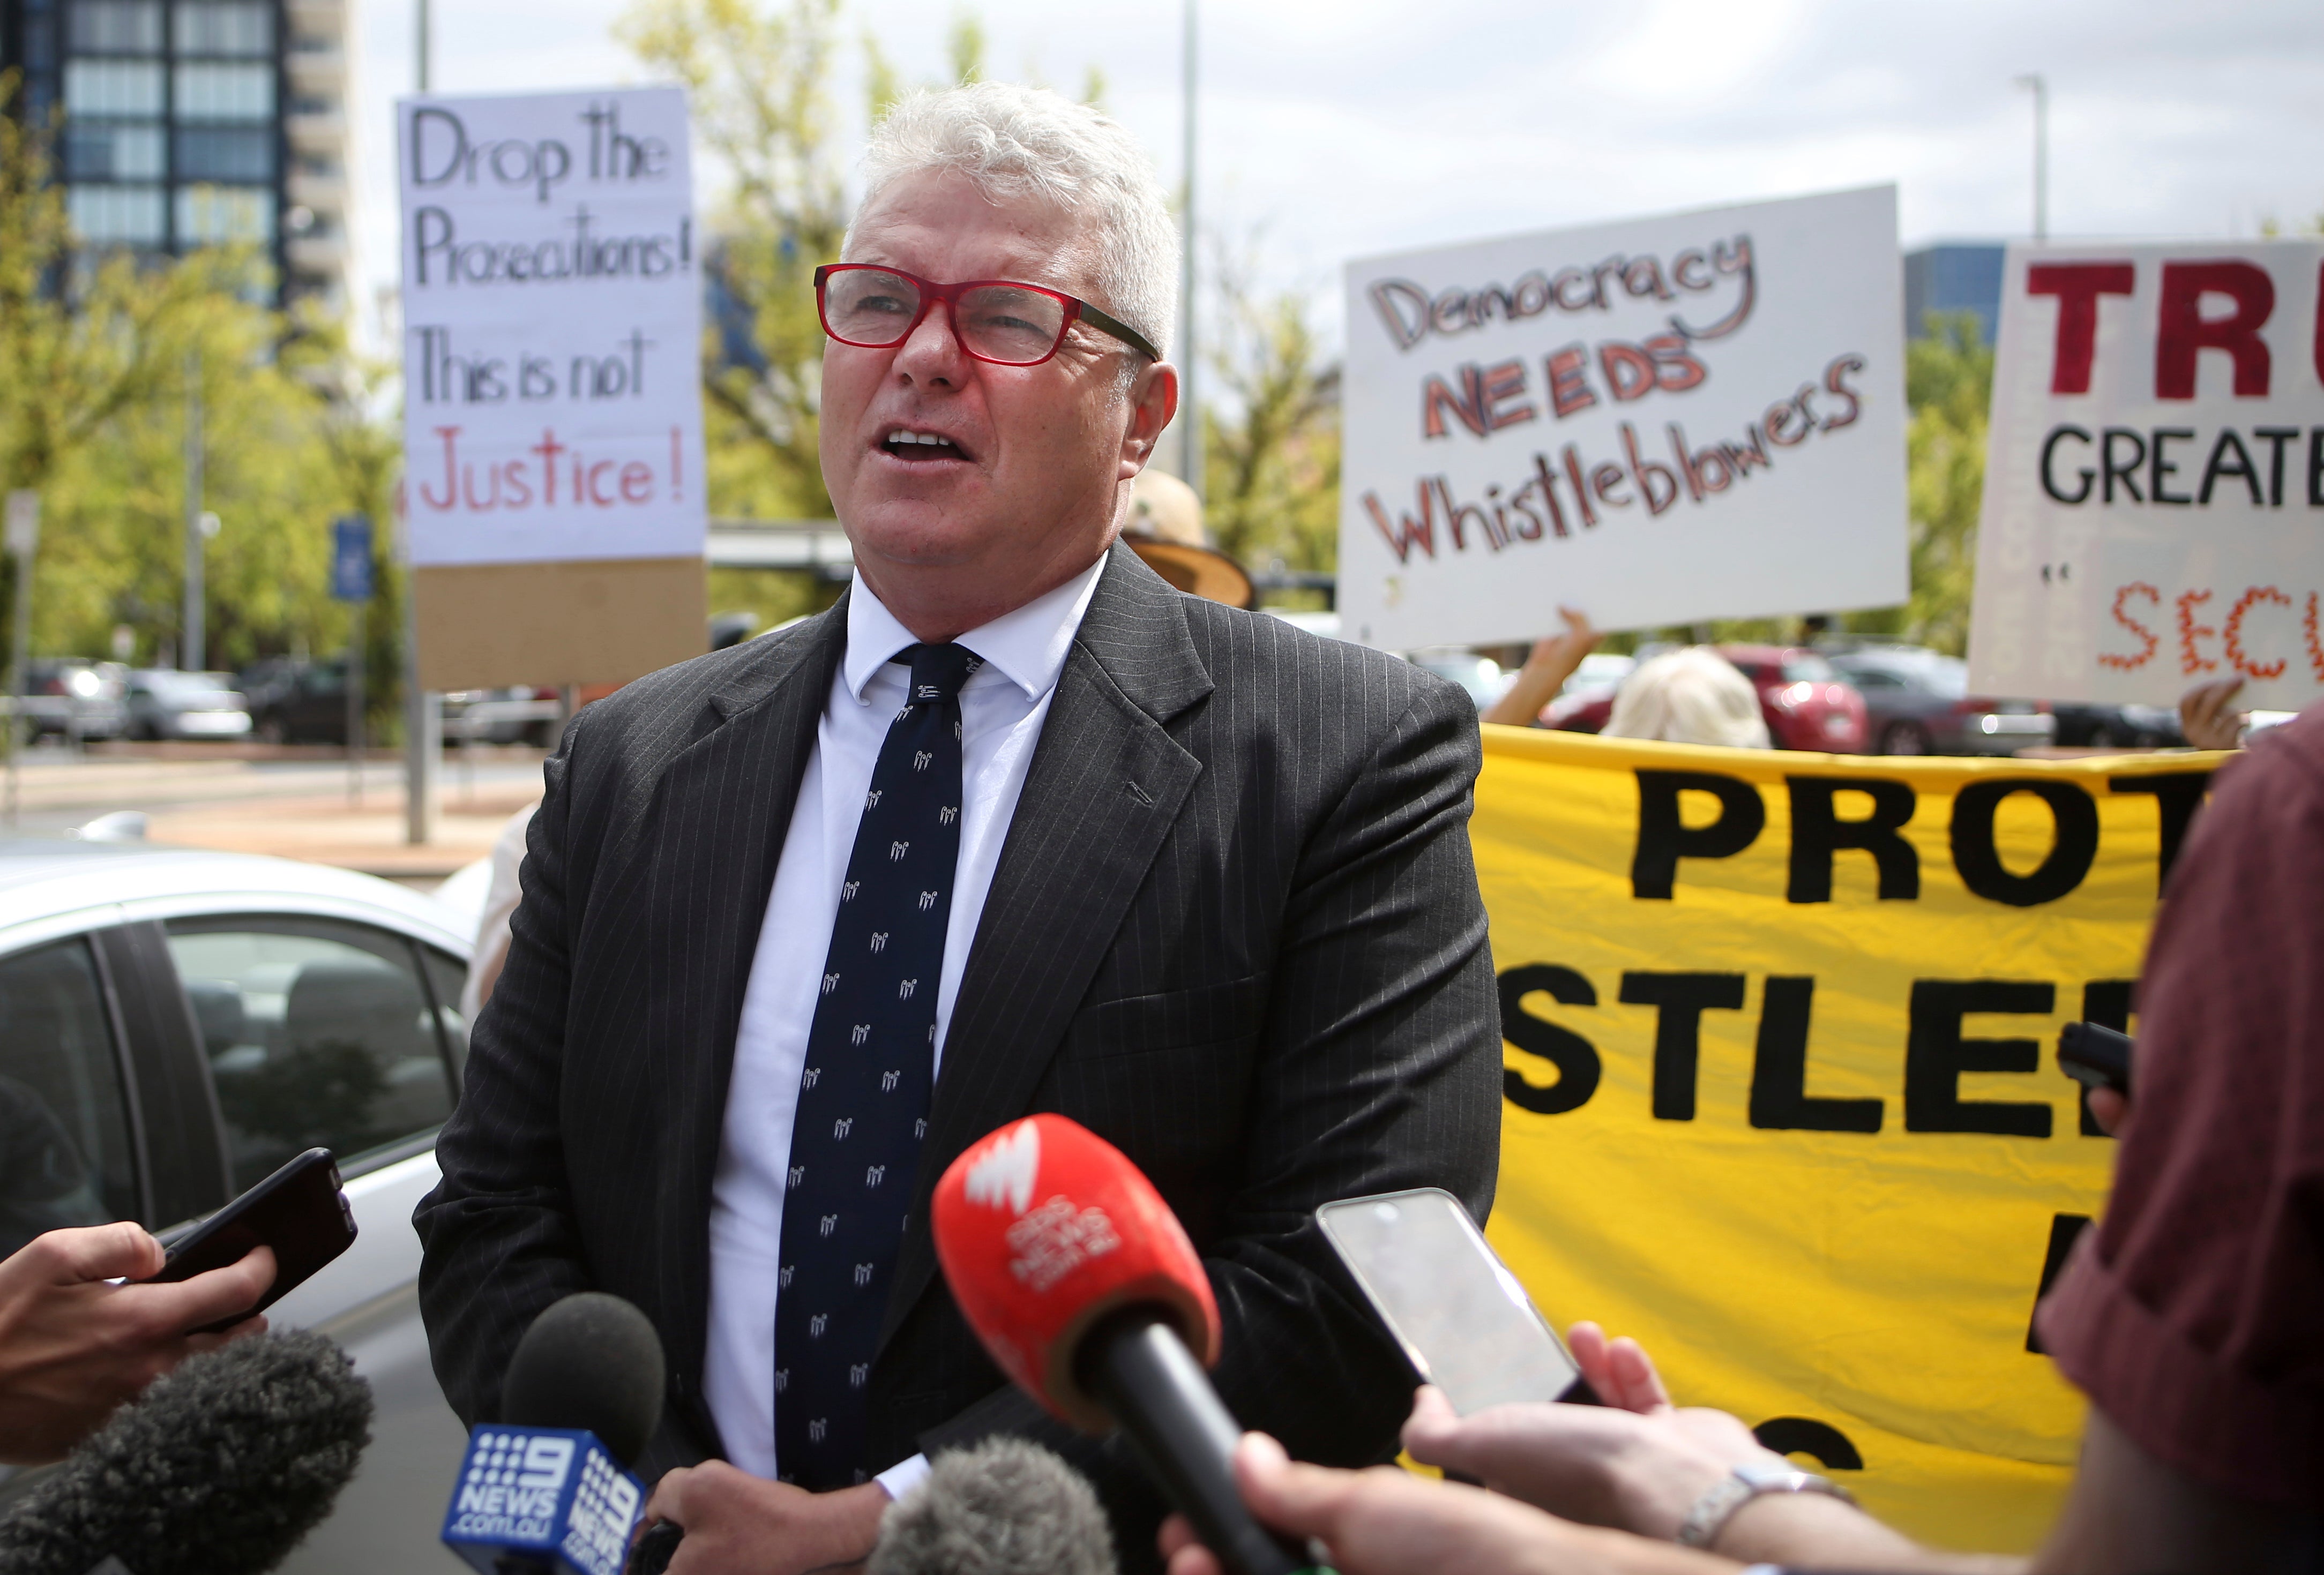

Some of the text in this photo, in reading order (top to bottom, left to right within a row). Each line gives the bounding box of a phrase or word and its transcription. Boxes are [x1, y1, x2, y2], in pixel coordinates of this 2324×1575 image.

[410, 100, 670, 202] Drop the
[1368, 230, 1756, 351] Democracy
[411, 324, 659, 406] This is not
[1423, 336, 1709, 440] NEEDS
[1362, 354, 1869, 563] Whistleblowers
[450, 1513, 551, 1541] .com.au
[457, 1482, 559, 1519] NEWS
[568, 1498, 625, 1568] NEWS
